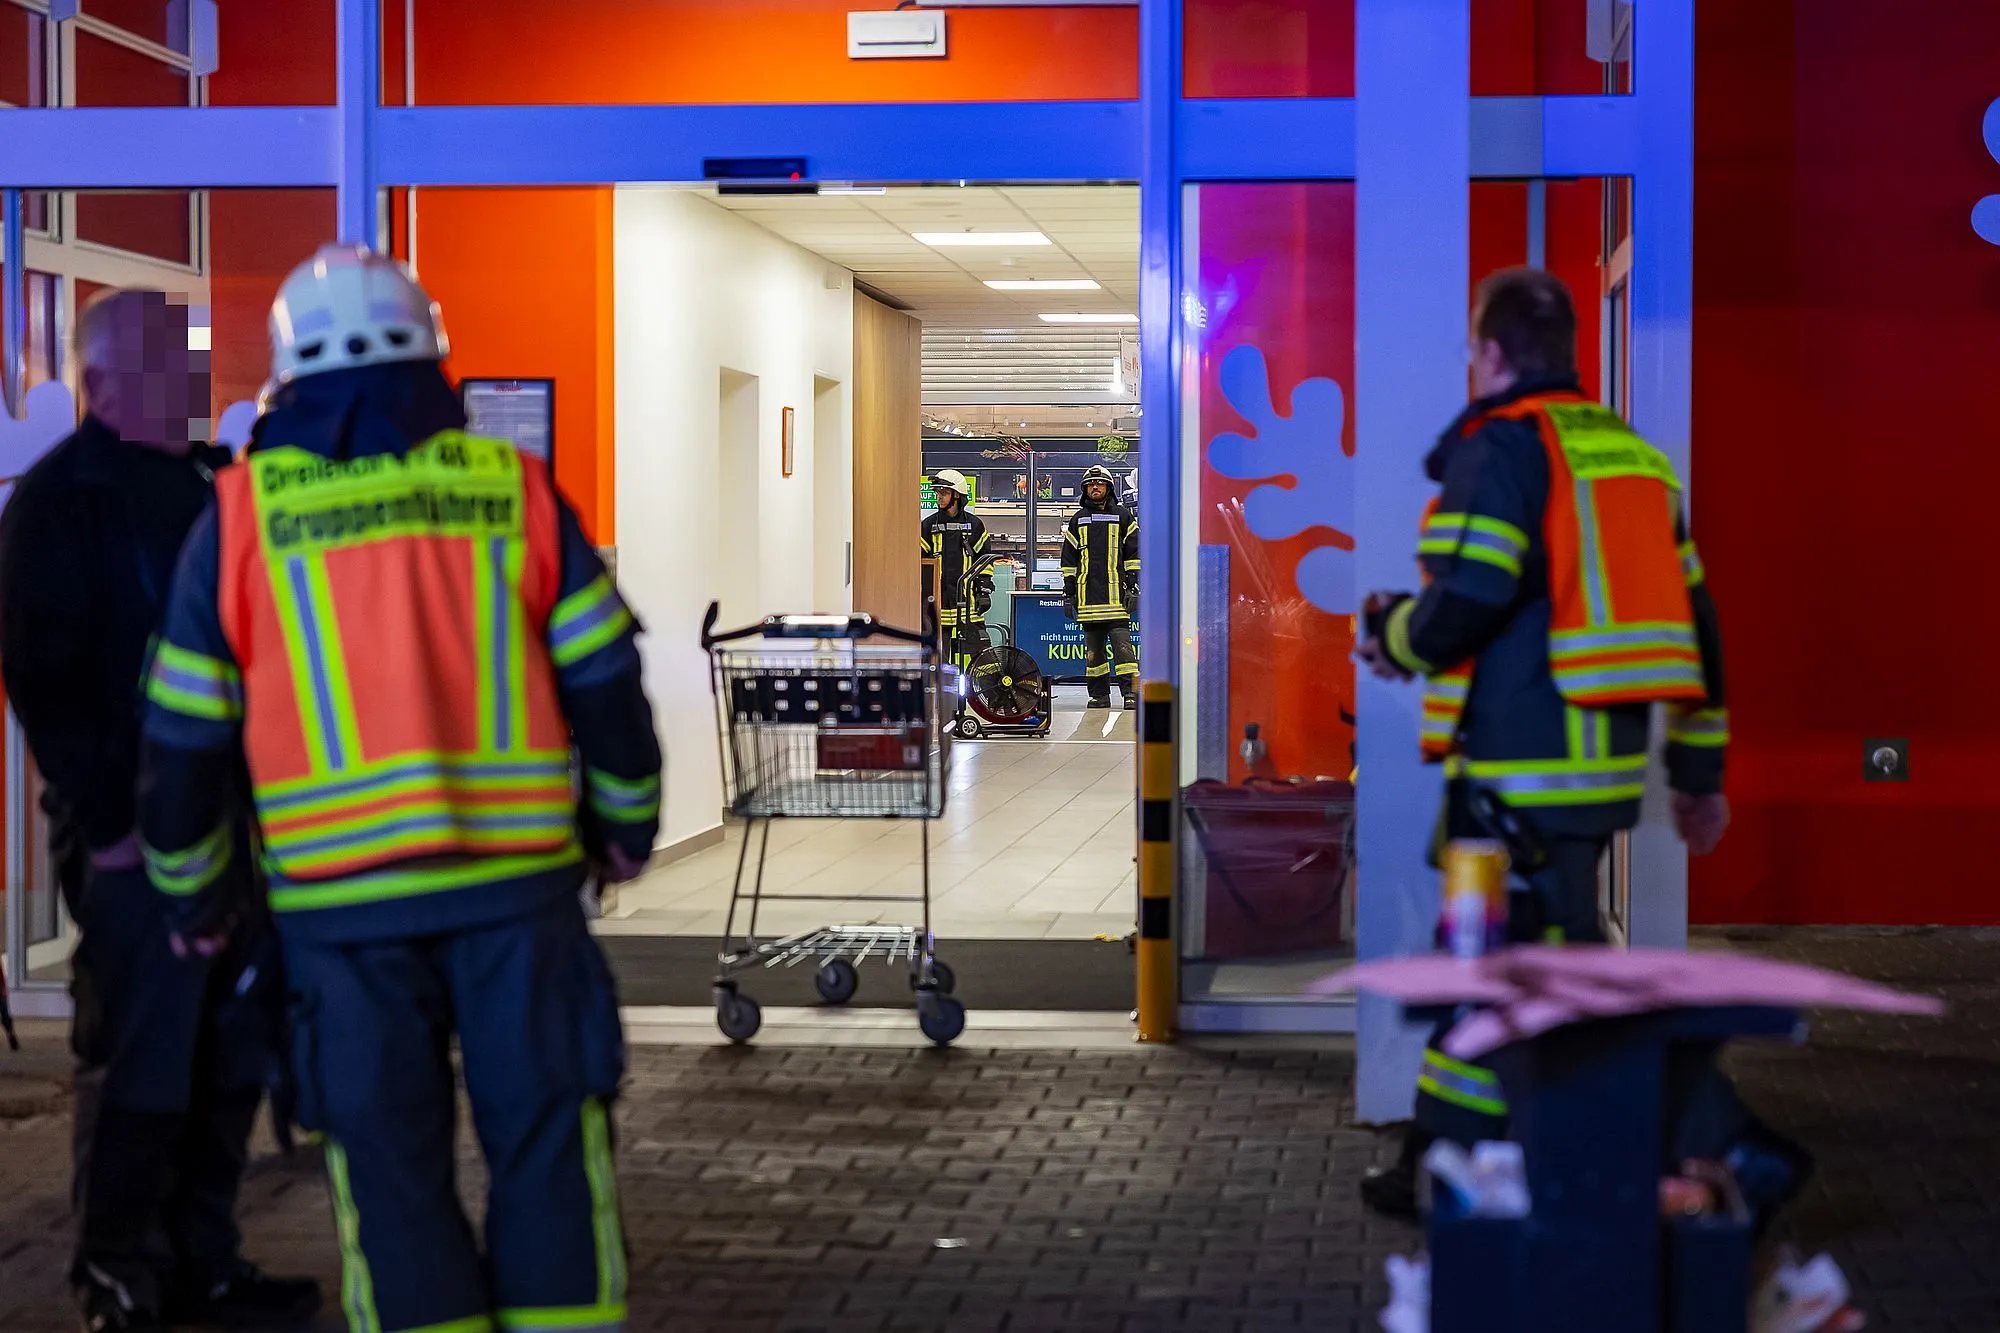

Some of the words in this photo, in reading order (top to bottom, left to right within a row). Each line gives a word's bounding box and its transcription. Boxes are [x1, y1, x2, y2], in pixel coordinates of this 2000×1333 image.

[1039, 599, 1065, 607] Restmül
[1064, 622, 1079, 631] Wir
[1040, 632, 1061, 641] nicht
